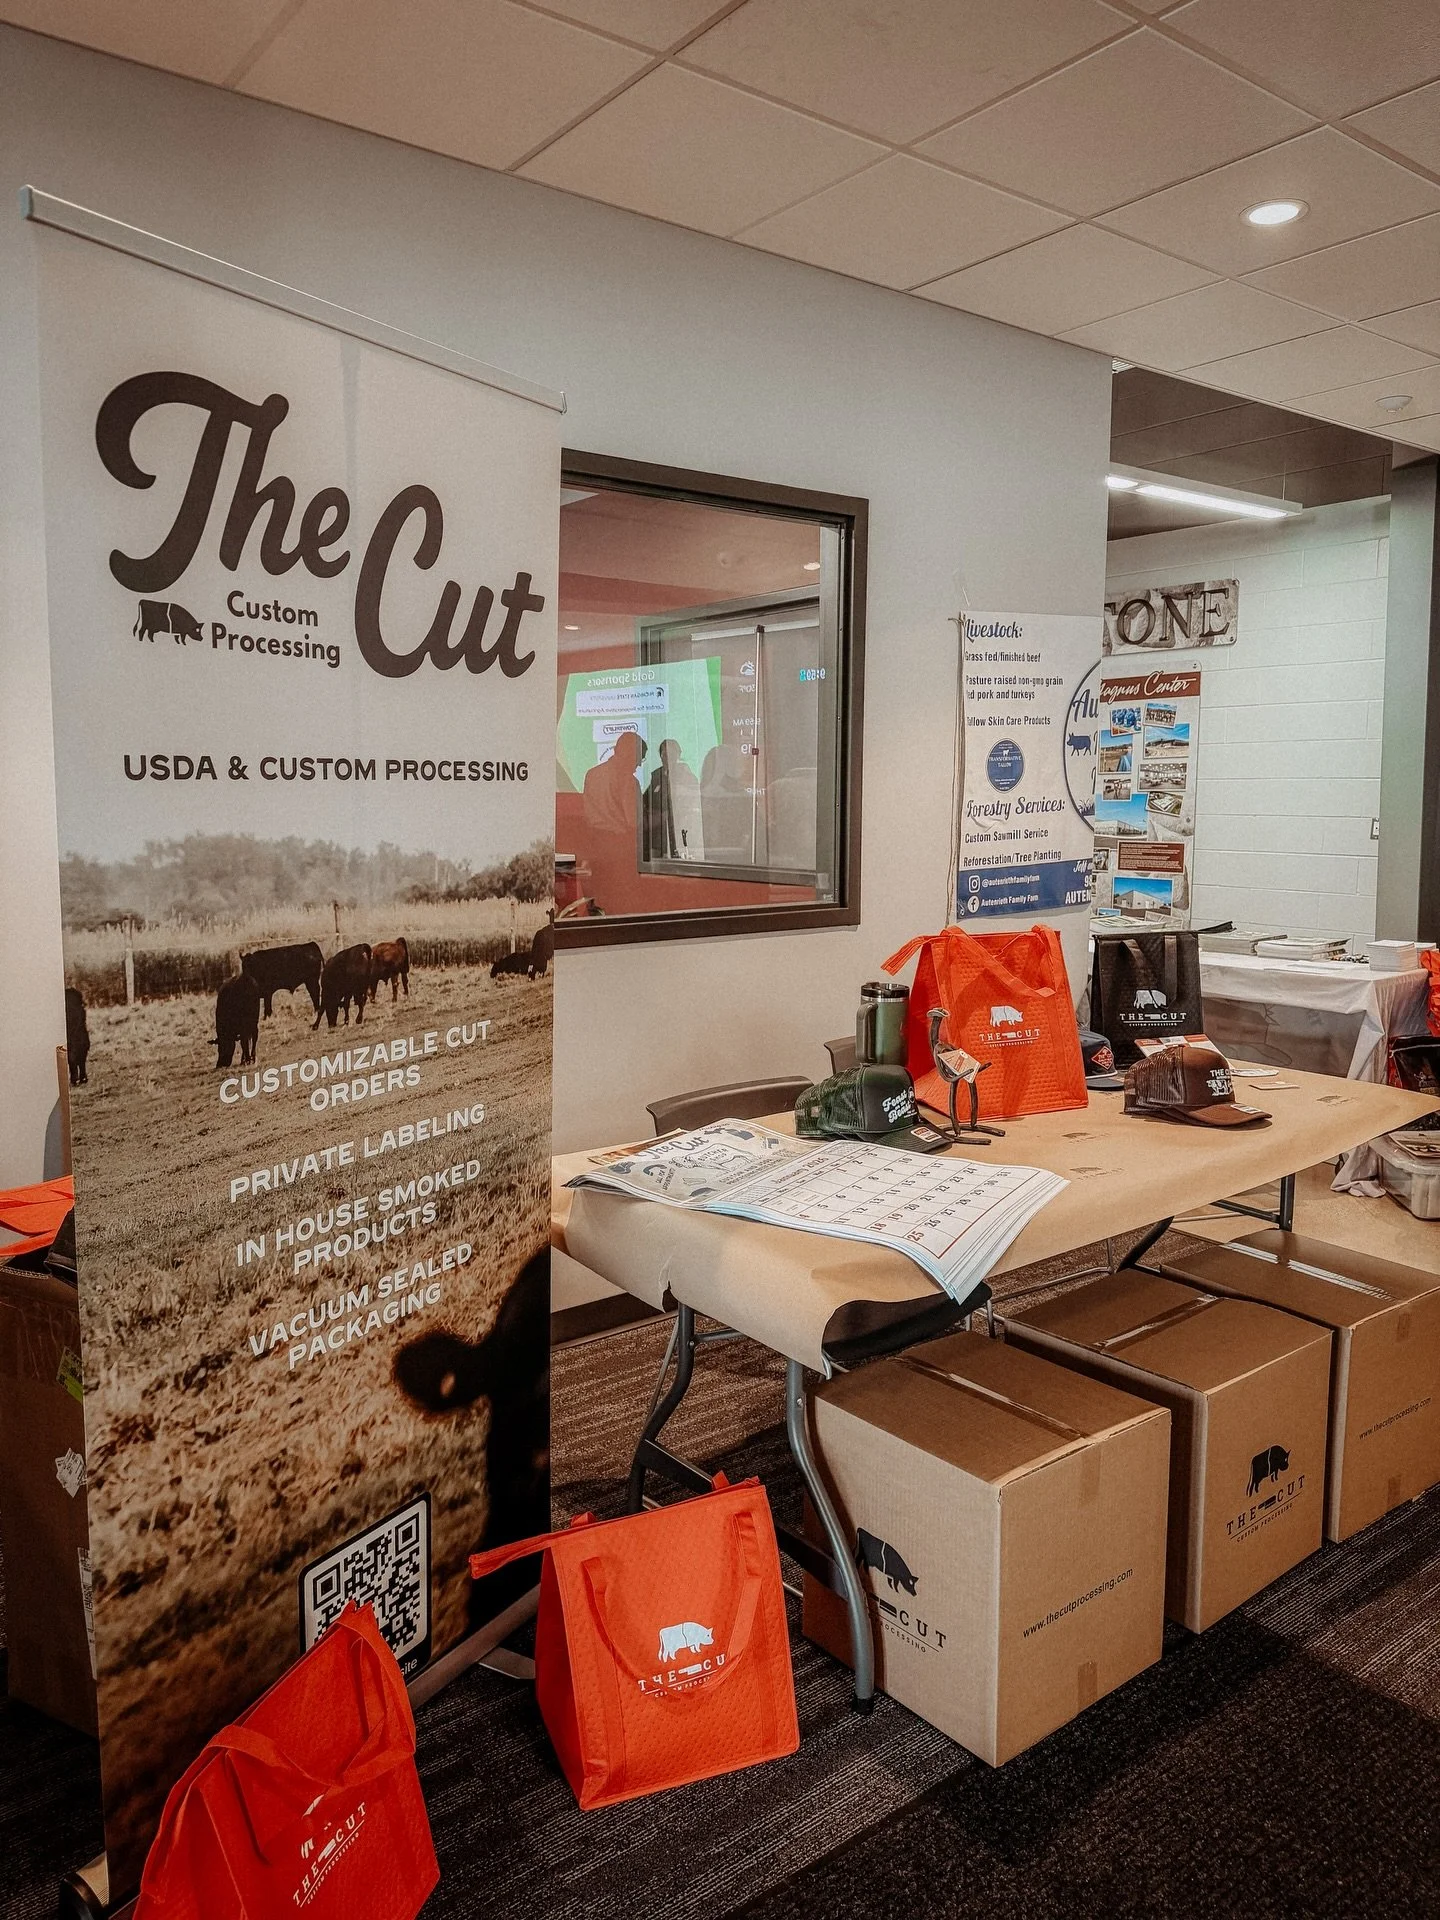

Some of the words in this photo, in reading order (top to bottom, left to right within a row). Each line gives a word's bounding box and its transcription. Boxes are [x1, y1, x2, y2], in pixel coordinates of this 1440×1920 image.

[95, 371, 351, 593] The
[354, 484, 546, 678] Cut
[226, 590, 319, 627] Custom
[211, 622, 341, 668] Processing
[965, 618, 1023, 643] Livestock:
[985, 651, 1026, 663] fed/finished
[1027, 652, 1041, 662] beef
[977, 690, 994, 701] pork
[996, 690, 1010, 699] and
[1011, 690, 1035, 701] turkeys
[994, 675, 1017, 685] raised
[1045, 677, 1064, 687] grain
[1143, 670, 1197, 696] Center
[988, 716, 1004, 726] Skin
[1006, 716, 1022, 725] Care
[1024, 716, 1051, 726] Products
[1072, 689, 1099, 722] Au
[123, 754, 217, 781] USDA
[228, 757, 249, 781] &
[260, 757, 377, 782] CUSTOM
[385, 759, 529, 782] PROCESSING
[966, 799, 1011, 820] Forestry
[1015, 796, 1066, 815] Services:
[965, 832, 991, 843] Custom
[994, 830, 1021, 841] Sawmill
[1024, 828, 1049, 838] Service
[963, 852, 1032, 867] Reforestation/Tree
[1033, 850, 1062, 862] Planting
[1065, 889, 1091, 904] AUTEN
[1120, 1013, 1144, 1021] THE
[1161, 1012, 1187, 1020] CUT
[979, 1032, 1002, 1041] THE
[1017, 1028, 1041, 1038] CUT
[219, 1031, 438, 1104] CUSTOMIZABLE
[446, 1020, 491, 1048] CUT
[310, 1064, 421, 1112] ORDERS
[230, 1141, 354, 1203] PRIVATE
[364, 1103, 485, 1160] LABELING
[237, 1234, 265, 1267] IN
[275, 1197, 369, 1251] HOUSE
[378, 1159, 481, 1211] SMOKED
[870, 1222, 887, 1230] 18
[907, 1230, 925, 1241] 25
[924, 1219, 941, 1227] 26
[941, 1208, 956, 1216] 27
[293, 1201, 437, 1275] PRODUCTS
[249, 1284, 369, 1357] VACUUM
[378, 1243, 473, 1299] SEALED
[288, 1282, 441, 1370] PACKAGING
[1226, 1506, 1257, 1536] THE
[1277, 1475, 1305, 1502] CUT
[1023, 1568, 1133, 1639] www.thecutprocessing.com
[881, 1622, 927, 1653] OCESSING
[899, 1610, 947, 1649] CUT
[400, 1658, 418, 1677] site
[703, 1653, 726, 1671] CU
[292, 1861, 319, 1906] THE
[335, 1801, 367, 1842] CUT
